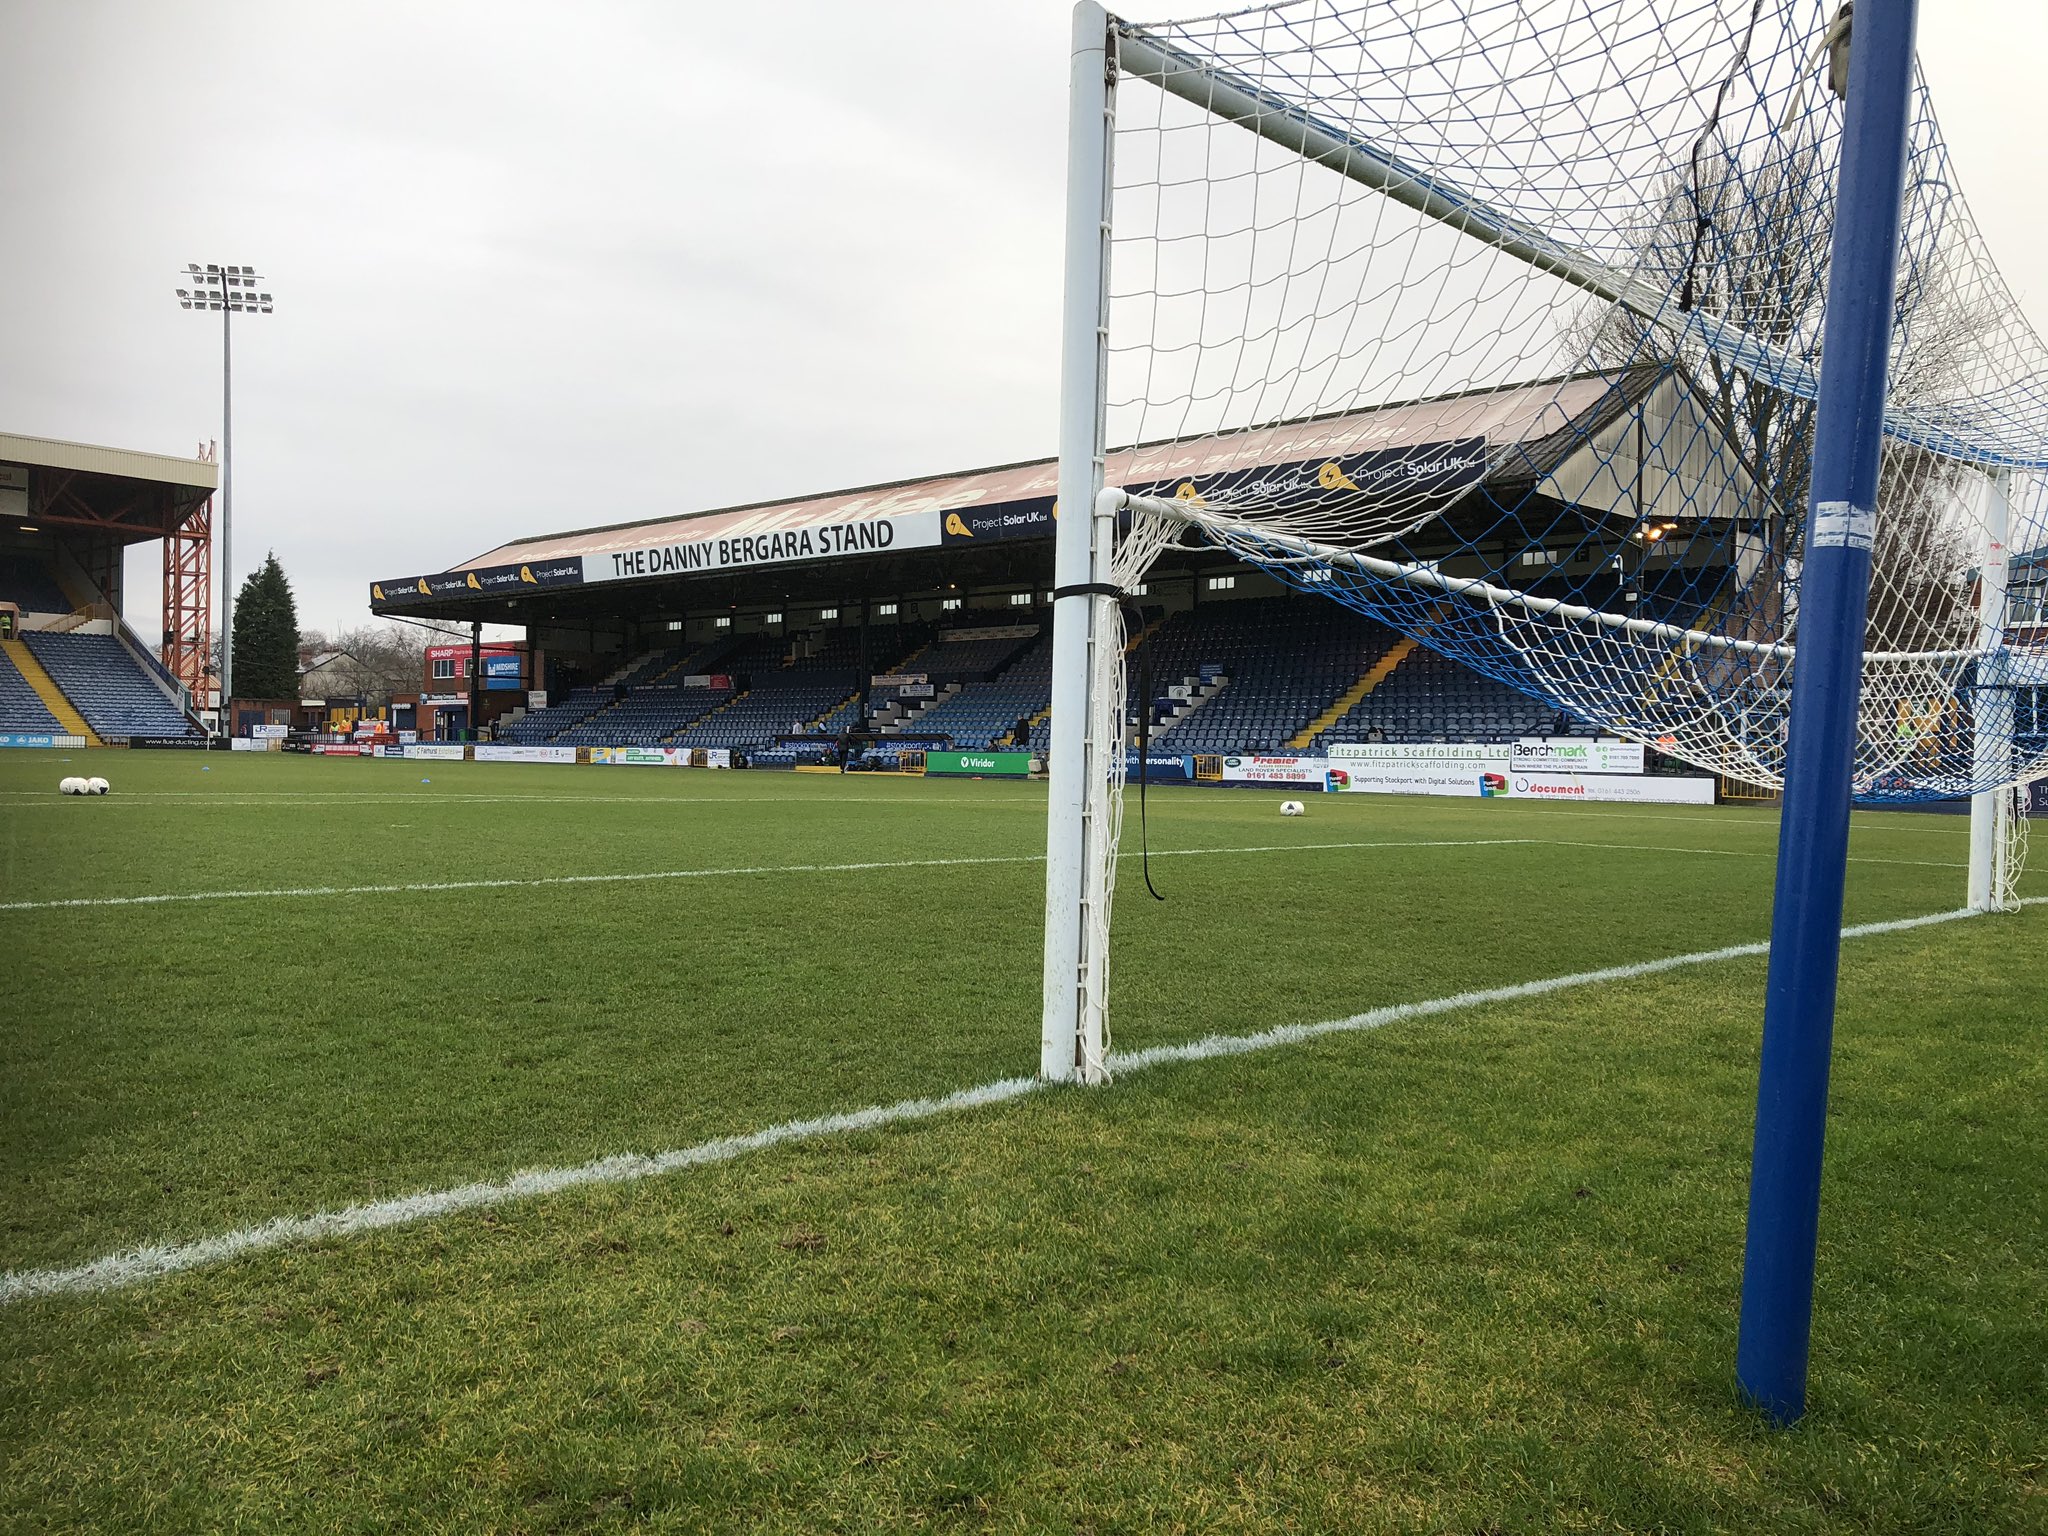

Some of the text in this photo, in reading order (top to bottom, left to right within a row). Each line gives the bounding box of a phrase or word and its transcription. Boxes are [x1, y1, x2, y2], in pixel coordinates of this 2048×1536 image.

[1126, 456, 1197, 475] Web
[1360, 467, 1404, 481] Project
[1407, 462, 1442, 475] Solar
[973, 519, 1002, 530] Project
[1003, 514, 1026, 526] Solar
[1026, 511, 1040, 523] UK
[612, 551, 645, 576] THE
[650, 542, 714, 572] DANNY
[719, 529, 813, 565] BERGARA
[819, 519, 894, 553] STAND
[537, 570, 553, 579] Project
[554, 568, 566, 576] Solar
[481, 577, 496, 585] Project
[497, 575, 508, 583] Solar
[431, 583, 445, 591] Project
[431, 649, 453, 657] SHARP
[496, 663, 519, 671] MIDSHIRE
[28, 736, 49, 744] JAKO
[145, 739, 217, 747] www.flue-ducting.couk
[1329, 746, 1510, 758] Fitzpatrick Scaffolding Ltd
[1513, 743, 1587, 757] Benchmark
[970, 758, 995, 769] Viridor
[1145, 756, 1185, 767] ersonality
[1253, 756, 1299, 764] Premier
[1350, 760, 1487, 770] www.fitzpatrickscaffolding.com
[1354, 775, 1475, 786] Supporting Stockport with Digital Solutions
[1530, 784, 1585, 794] document
